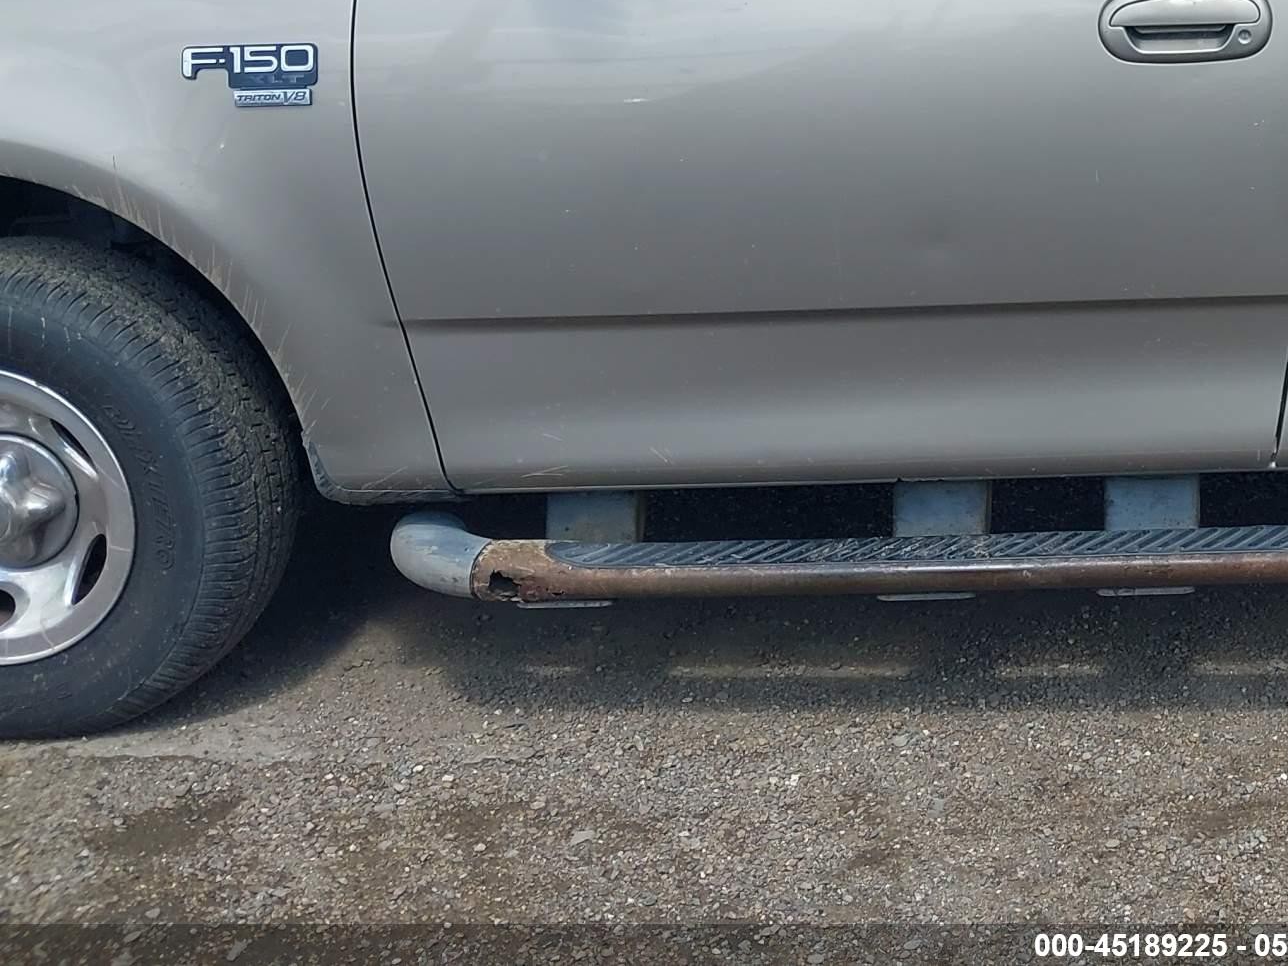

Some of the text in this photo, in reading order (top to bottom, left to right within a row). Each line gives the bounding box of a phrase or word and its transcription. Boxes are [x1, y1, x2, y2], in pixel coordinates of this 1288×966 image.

[182, 45, 314, 77] F-150
[236, 91, 307, 106] TRITON V8
